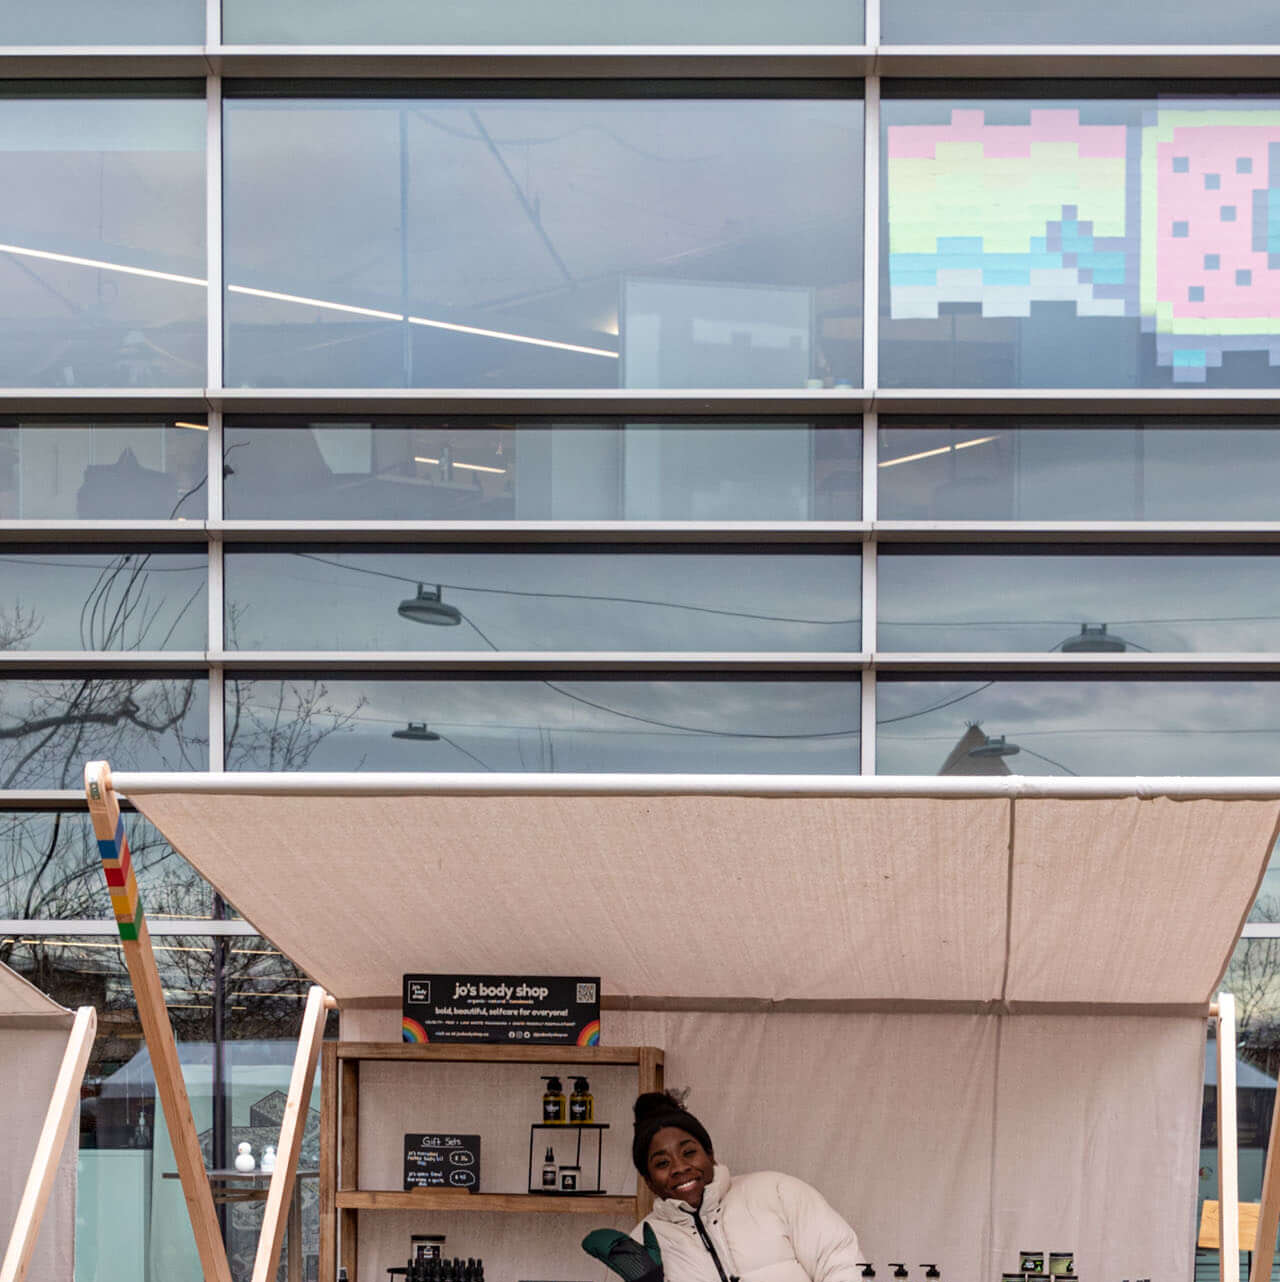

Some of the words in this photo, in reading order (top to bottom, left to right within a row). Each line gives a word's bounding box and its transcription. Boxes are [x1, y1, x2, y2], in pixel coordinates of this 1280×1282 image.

[453, 982, 477, 1000] jo's
[479, 983, 513, 1000] body
[515, 983, 549, 1001] shop
[454, 1007, 488, 1016] beautiful,
[520, 1008, 530, 1016] for
[422, 1136, 441, 1146] Gift
